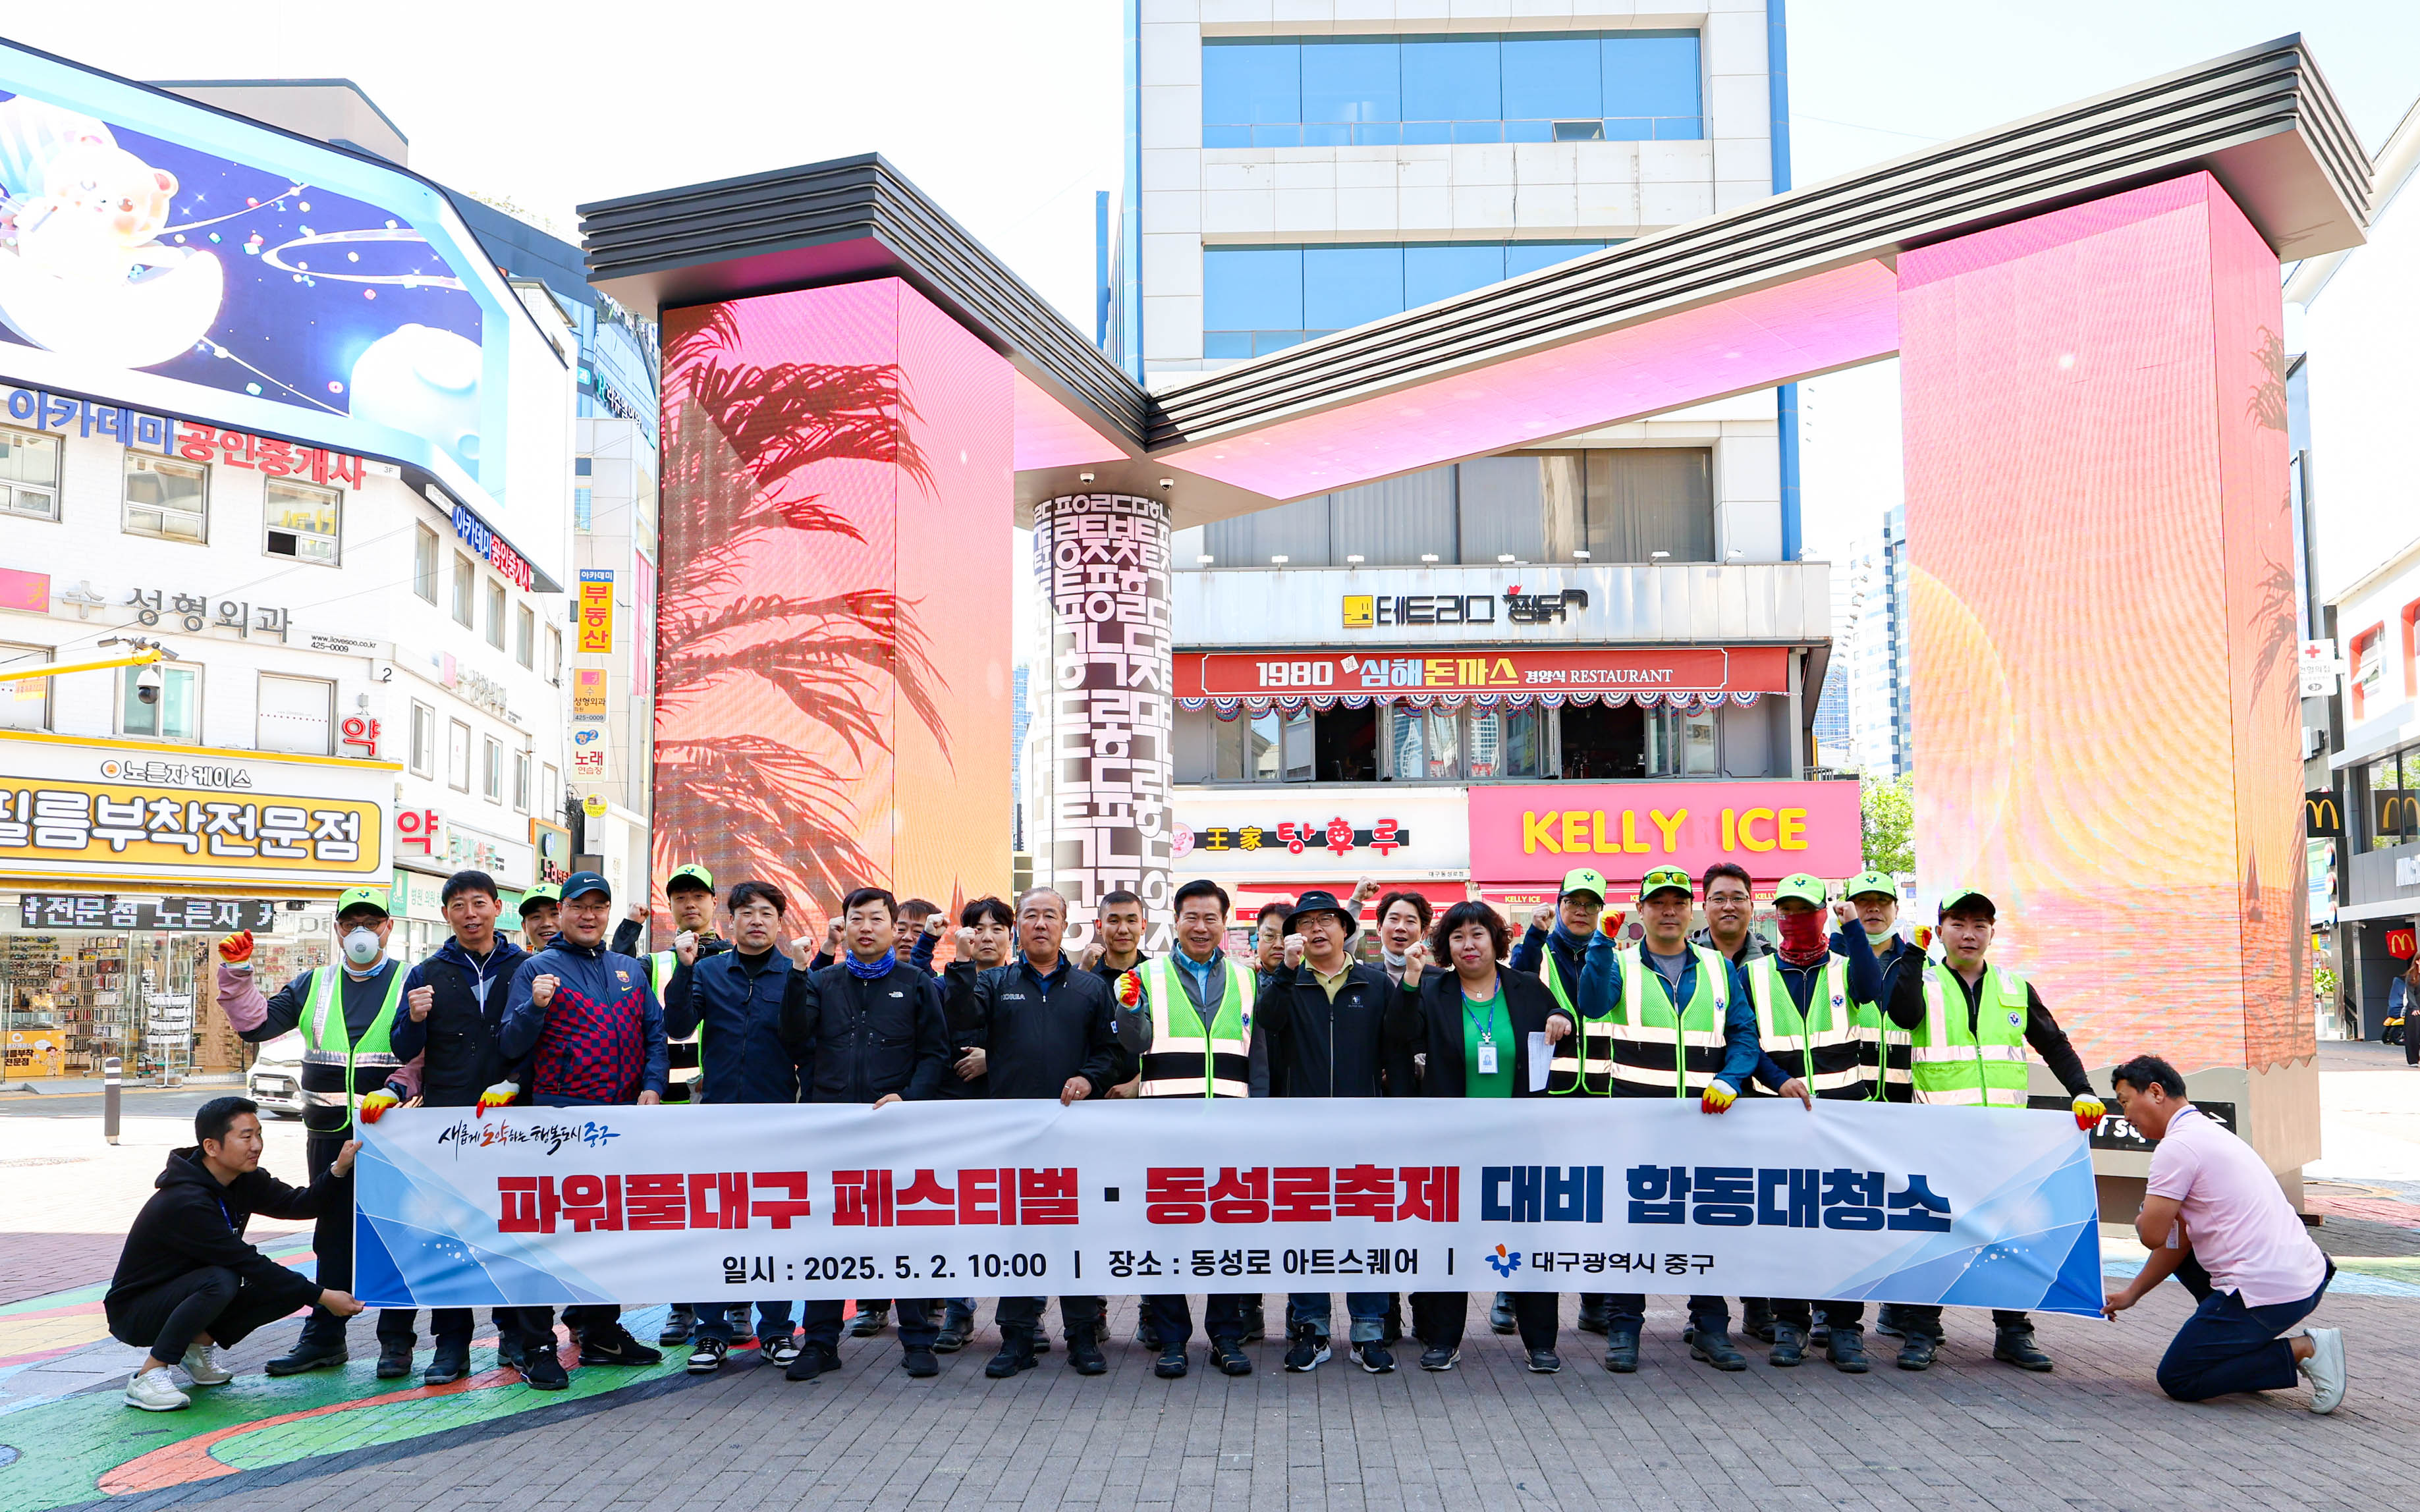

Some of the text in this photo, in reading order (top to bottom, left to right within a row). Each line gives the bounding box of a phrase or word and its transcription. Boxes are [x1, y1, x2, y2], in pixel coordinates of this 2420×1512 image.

[9, 390, 366, 491] 아카데미 공인중개사
[581, 571, 613, 580] 아카데미
[63, 580, 292, 643] 수 성형외과
[584, 585, 609, 649] 부동산
[311, 635, 376, 649] www.ilovesoo.co.kr
[311, 641, 348, 653] 425-0009
[383, 667, 392, 681] 2
[1257, 660, 1334, 687] 1980
[1524, 670, 1566, 684] 경양식
[1570, 669, 1673, 683] RESTAURANT
[574, 697, 606, 706] 성형외과
[585, 686, 594, 696] 수
[341, 716, 381, 756] 약
[575, 751, 603, 766] 노래
[578, 766, 603, 775] 연습장
[124, 760, 252, 788] 노른자 케이스
[397, 810, 439, 854] 약
[1205, 816, 1400, 857] 王家 탕후루
[1523, 807, 1808, 854] KELLY ICE
[153, 899, 242, 929] 노른자
[437, 1119, 620, 1162] 새롭게 도약하는 행복도시 중구
[497, 1170, 811, 1234] 파워풀대구
[831, 1167, 1079, 1227] 페스티벌
[1145, 1164, 1460, 1224] 동성로축제
[1481, 1165, 1604, 1223] 대비
[1626, 1164, 1952, 1233] 합동대청소
[722, 1255, 775, 1284] 일시
[805, 1255, 883, 1282] 2025.
[894, 1255, 920, 1280] 5.
[931, 1254, 956, 1279] 2.
[968, 1253, 1047, 1278] 10:00
[1109, 1250, 1162, 1278] 장소
[1191, 1249, 1271, 1277] 동성로
[1283, 1248, 1418, 1276] 아트스퀘어
[1531, 1251, 1715, 1275] 대구광역시 중구
